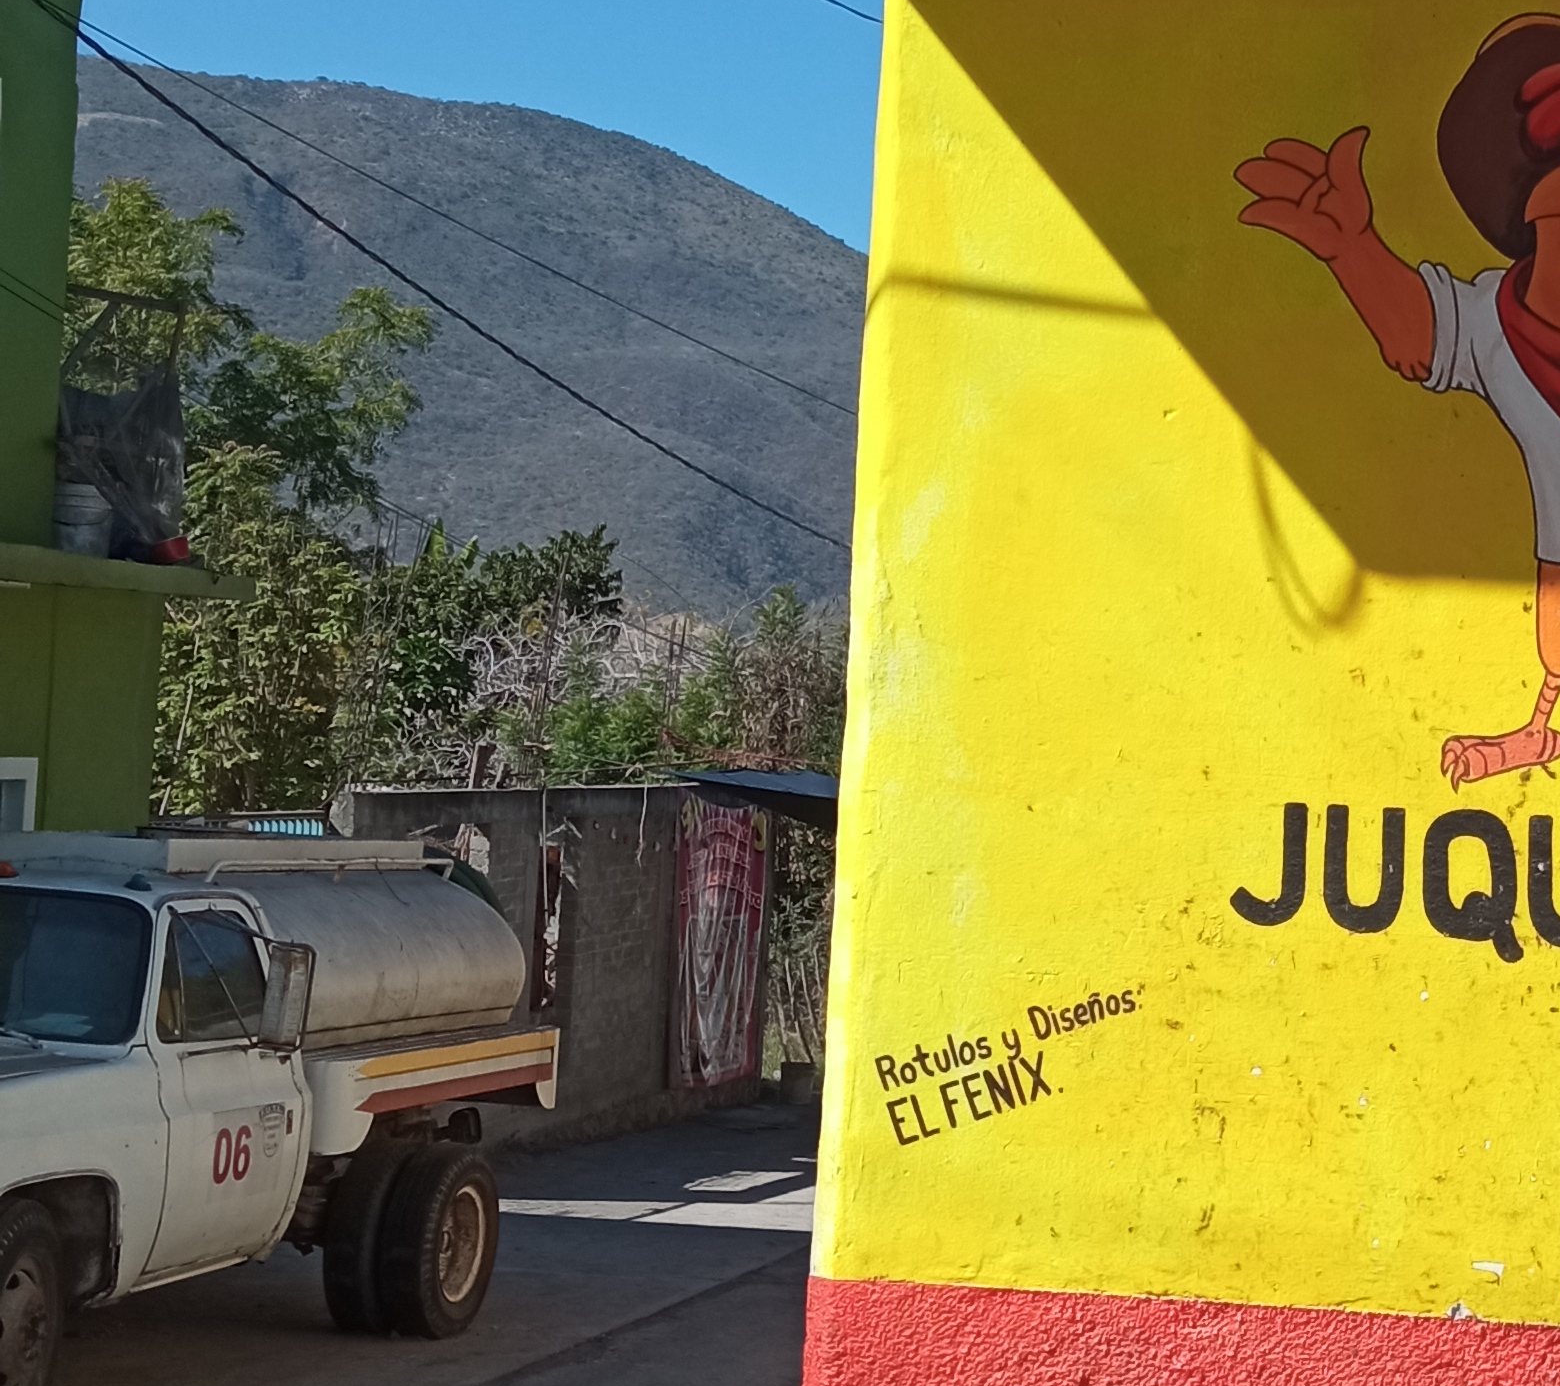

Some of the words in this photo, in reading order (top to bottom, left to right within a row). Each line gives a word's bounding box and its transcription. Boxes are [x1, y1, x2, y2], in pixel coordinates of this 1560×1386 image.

[874, 1033, 993, 1092] Rotulos
[1001, 1028, 1023, 1061] y
[886, 1094, 941, 1146] EL
[212, 1124, 252, 1184] 06
